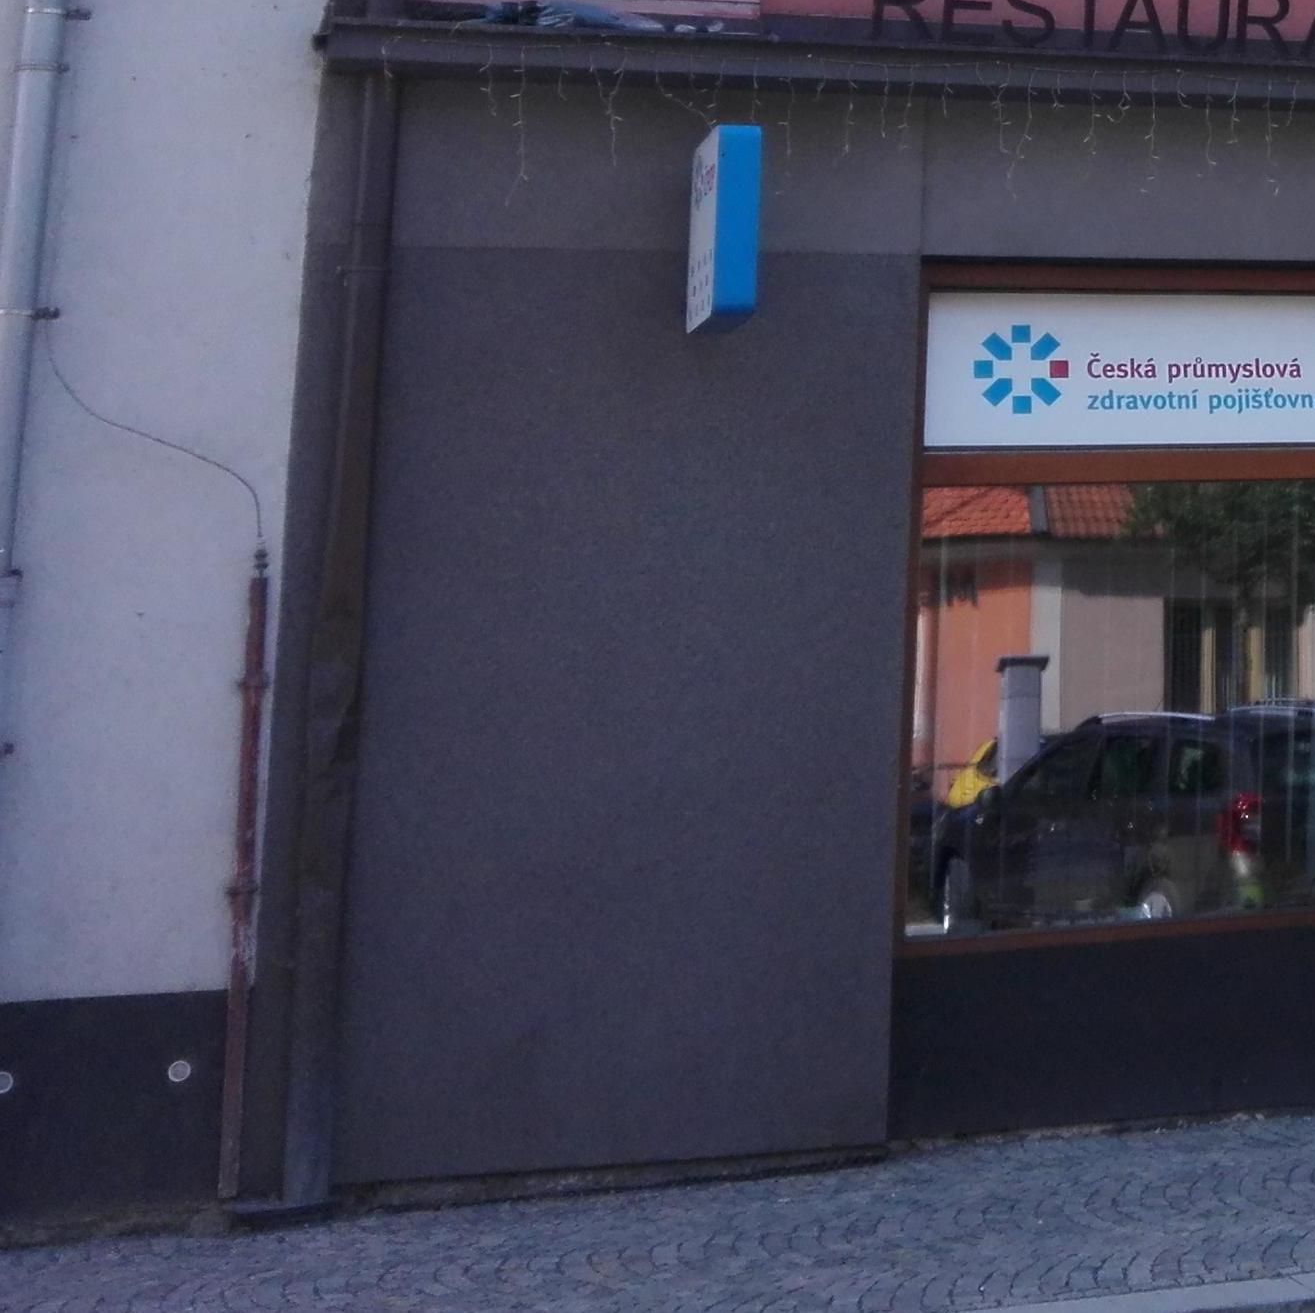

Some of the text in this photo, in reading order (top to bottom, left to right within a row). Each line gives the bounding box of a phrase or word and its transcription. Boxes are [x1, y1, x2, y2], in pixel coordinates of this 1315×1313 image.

[1087, 353, 1301, 383] Česká průmyslová
[1087, 388, 1198, 410] zdravotní
